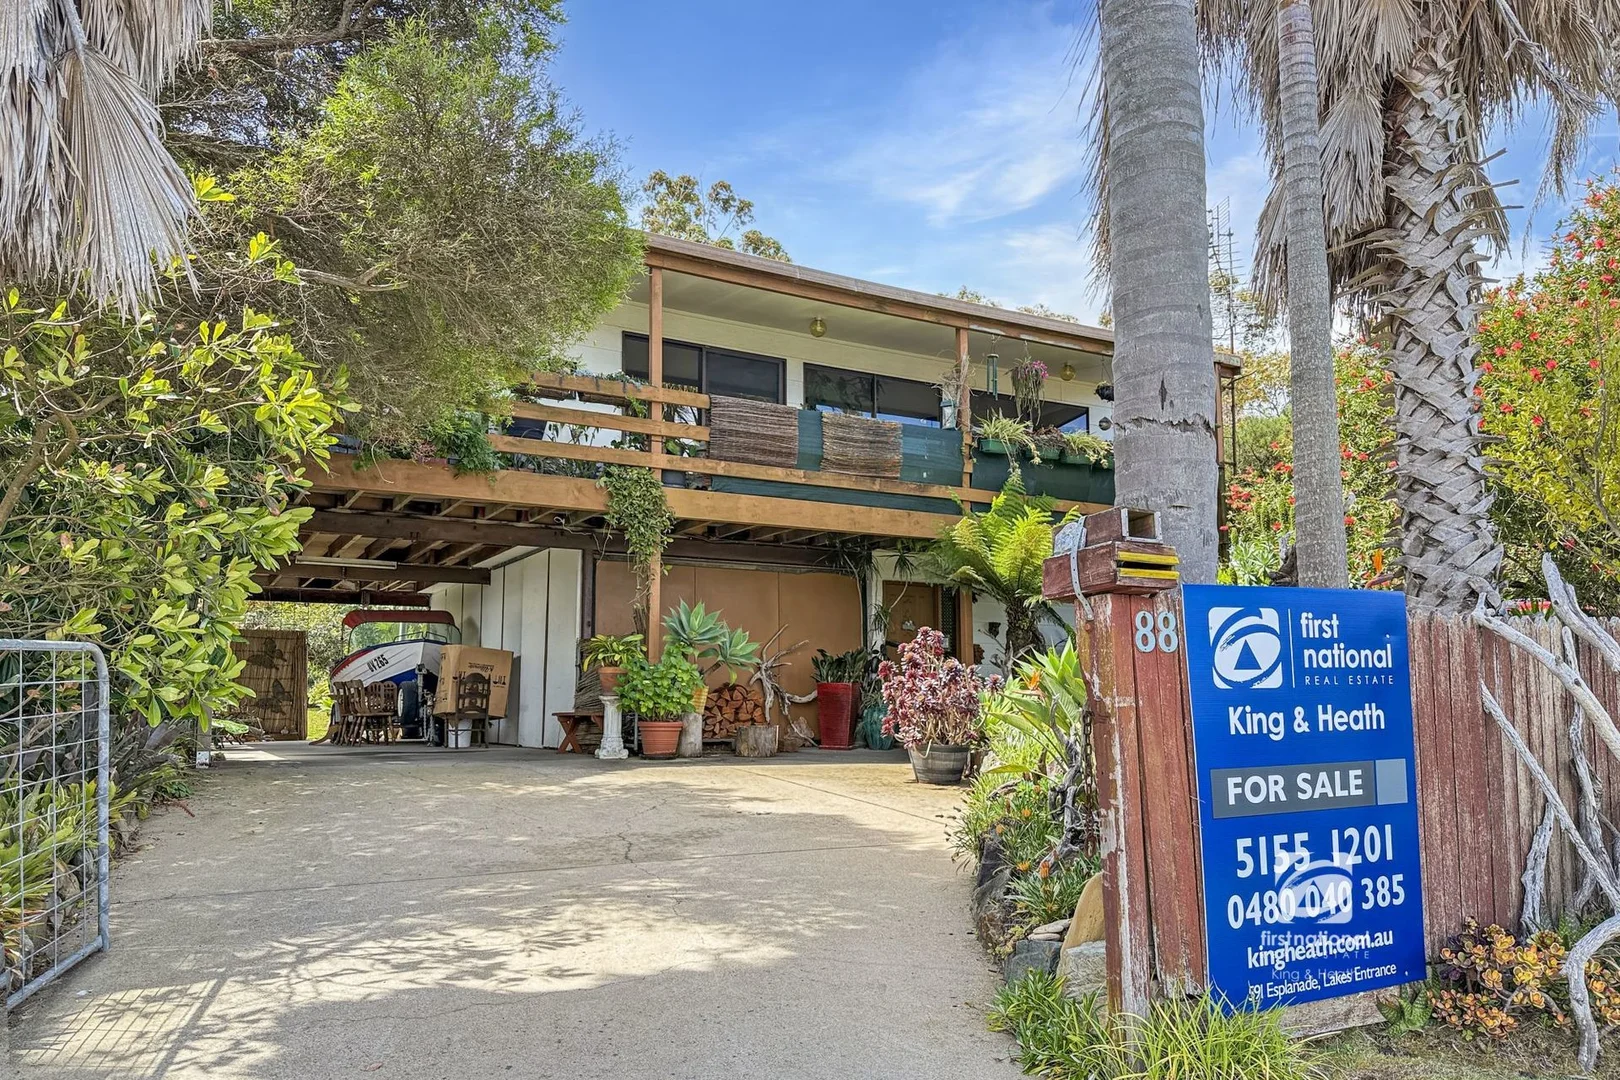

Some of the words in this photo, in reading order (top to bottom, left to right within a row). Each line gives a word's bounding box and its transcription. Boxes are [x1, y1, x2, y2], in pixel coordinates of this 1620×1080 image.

[1135, 610, 1178, 653] 88
[1300, 611, 1339, 639] first
[1303, 642, 1393, 669] national
[1305, 675, 1338, 686] REAL
[1348, 675, 1394, 685] ESTATE
[1228, 704, 1285, 741] King
[1293, 705, 1310, 733] &
[1317, 702, 1385, 732] Heath
[1227, 773, 1287, 806] FOR
[1296, 769, 1363, 800] SALE
[1236, 832, 1311, 878] 5155
[1331, 824, 1394, 868] 1201
[1227, 888, 1297, 929] 0480
[1305, 881, 1352, 918] 040
[1361, 874, 1405, 910] 385
[1247, 930, 1394, 970] kingheath.com.au
[1266, 976, 1321, 999] Esplanade,
[1323, 971, 1352, 988] Lakes
[1354, 963, 1397, 981] Entrance
